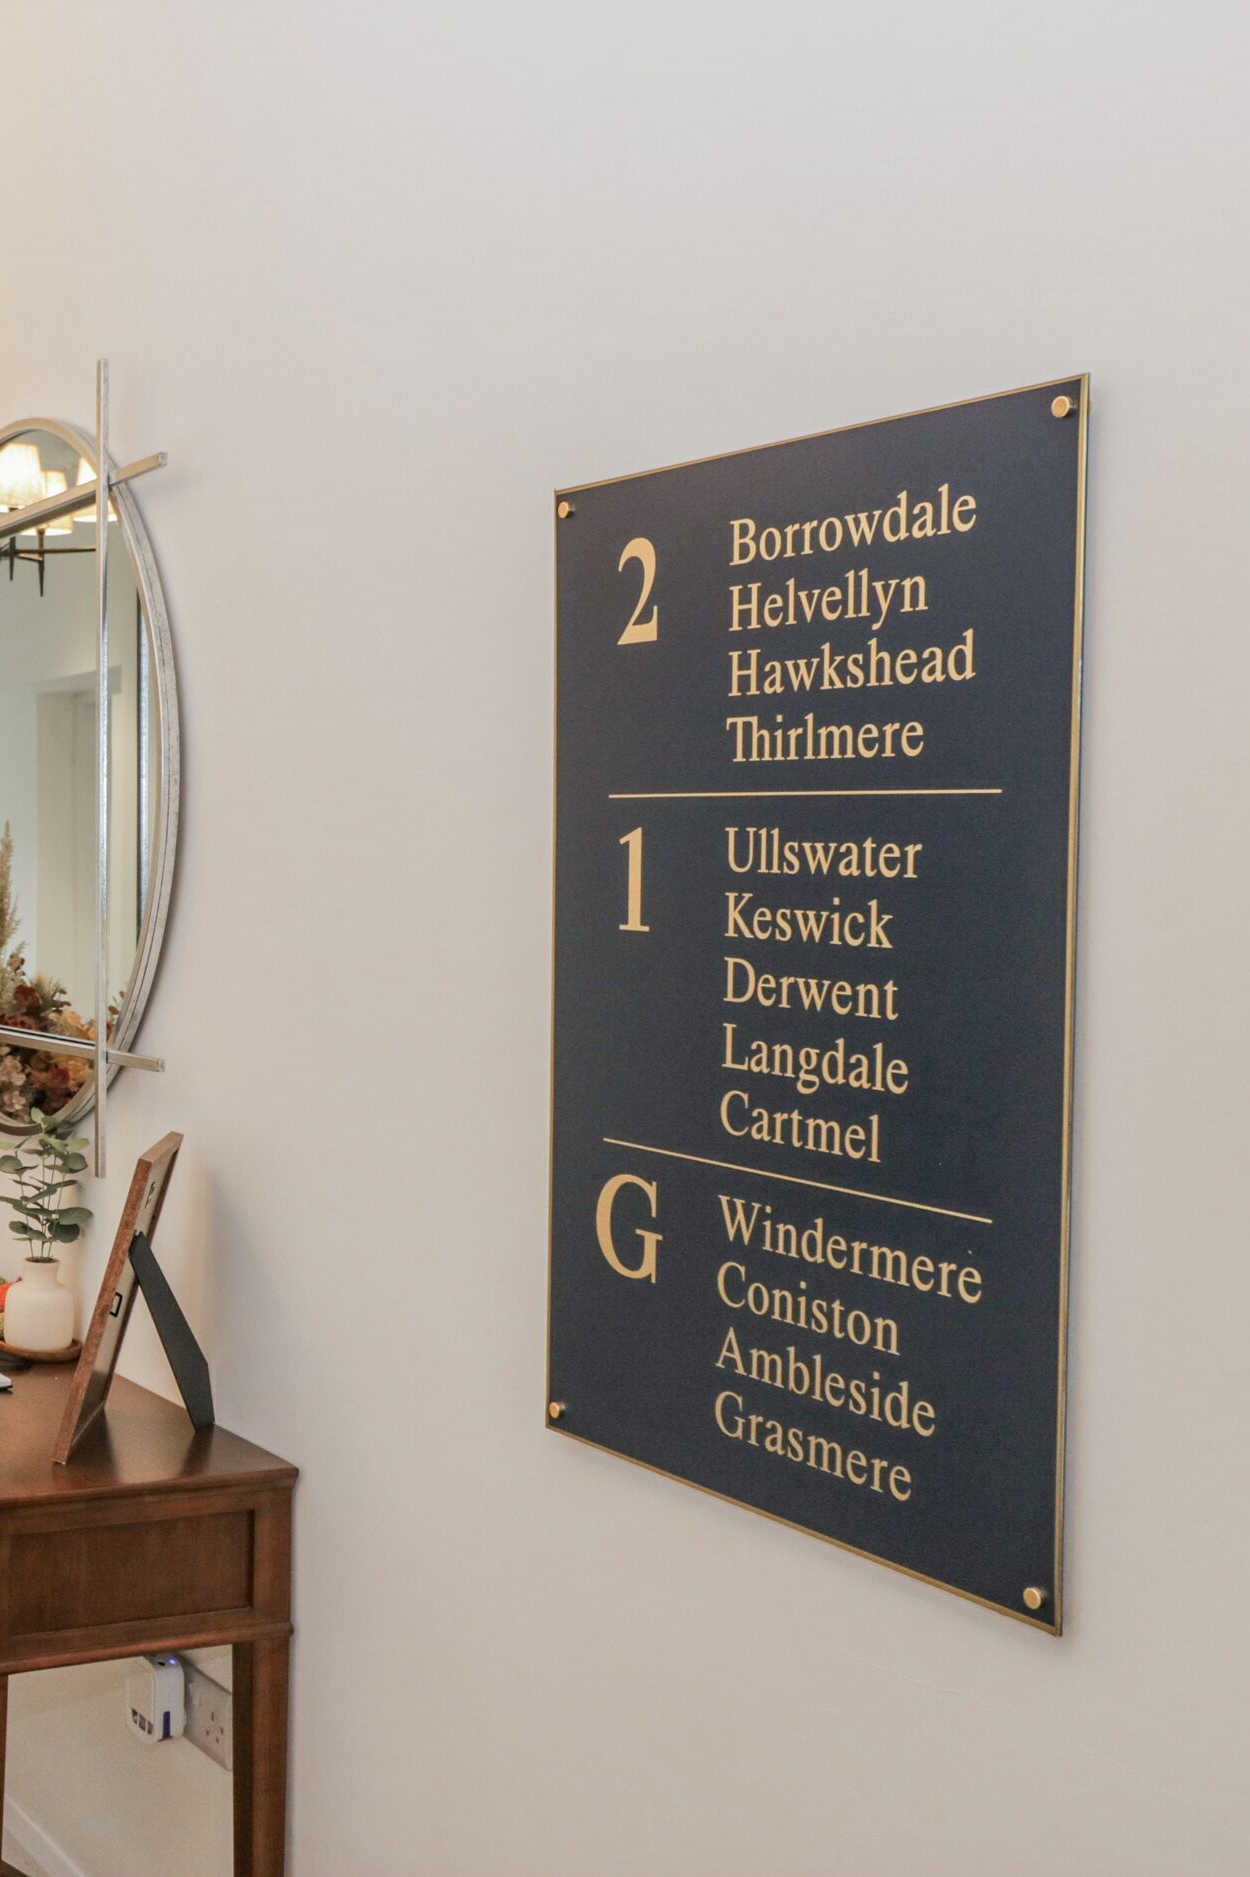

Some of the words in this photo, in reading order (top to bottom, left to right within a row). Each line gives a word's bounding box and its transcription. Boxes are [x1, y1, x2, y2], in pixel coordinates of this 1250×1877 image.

[729, 483, 977, 566] Borrowdale
[617, 537, 658, 646] 2
[729, 568, 929, 632] Helvellyn
[728, 628, 977, 697] Hawkshead
[726, 713, 925, 763] Thirlmere
[618, 827, 650, 933] 1
[724, 827, 923, 879] Ullswater
[724, 892, 894, 949] Keswick
[723, 957, 899, 1021] Derwent
[722, 1023, 909, 1095] Langdale
[720, 1091, 881, 1163] Cartmel
[596, 1174, 663, 1284] G
[717, 1195, 982, 1304] Windermere
[717, 1262, 900, 1356] Coniston
[715, 1327, 936, 1437] Ambleside
[714, 1391, 912, 1501] Grasmere
